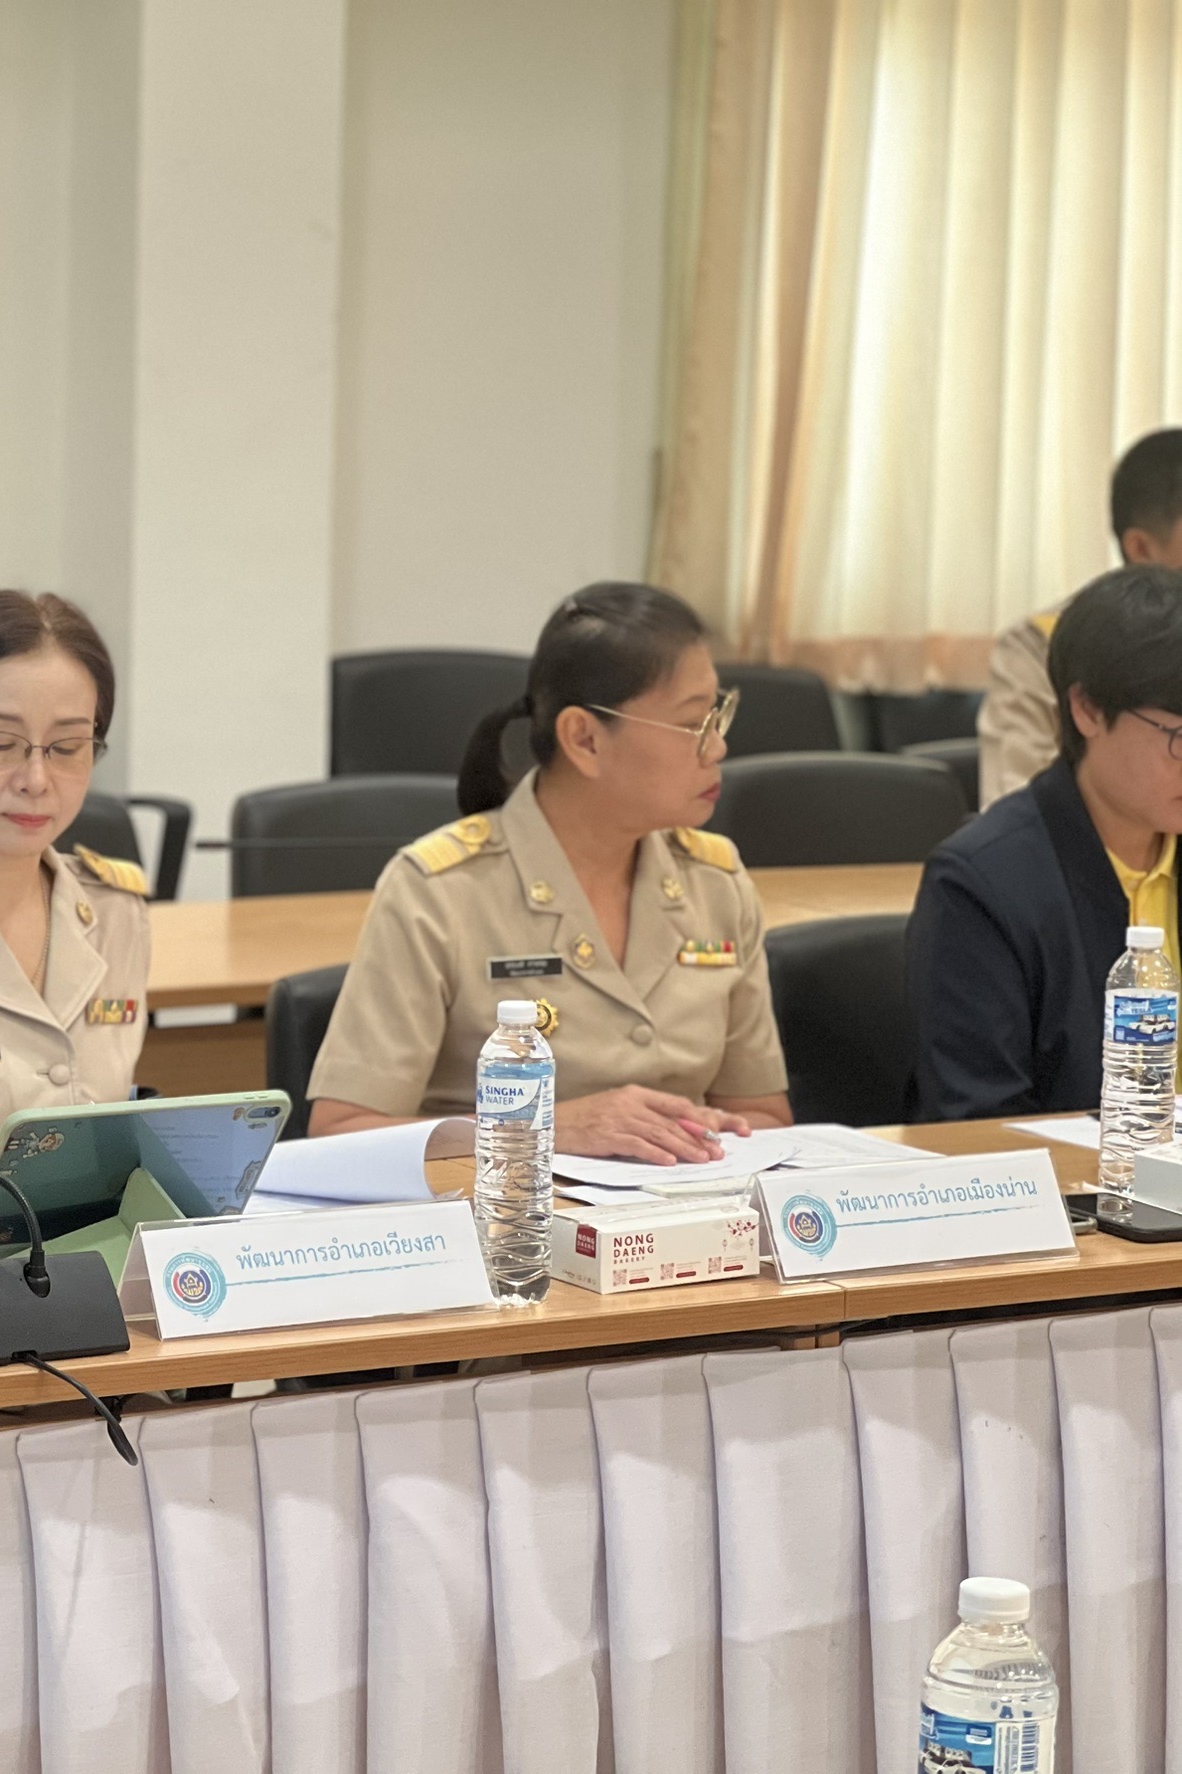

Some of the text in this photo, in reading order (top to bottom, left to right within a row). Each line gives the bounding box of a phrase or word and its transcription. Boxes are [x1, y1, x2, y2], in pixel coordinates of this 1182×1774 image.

[485, 1085, 524, 1097] SINGHA
[486, 1095, 514, 1105] WATER
[836, 1176, 1038, 1213] พัฒนาการอำเภอเมืองน่าน
[613, 1233, 654, 1248] NONG
[236, 1231, 446, 1270] พัฒนาการอำเภอเวียงสา
[613, 1245, 654, 1258] DAENG
